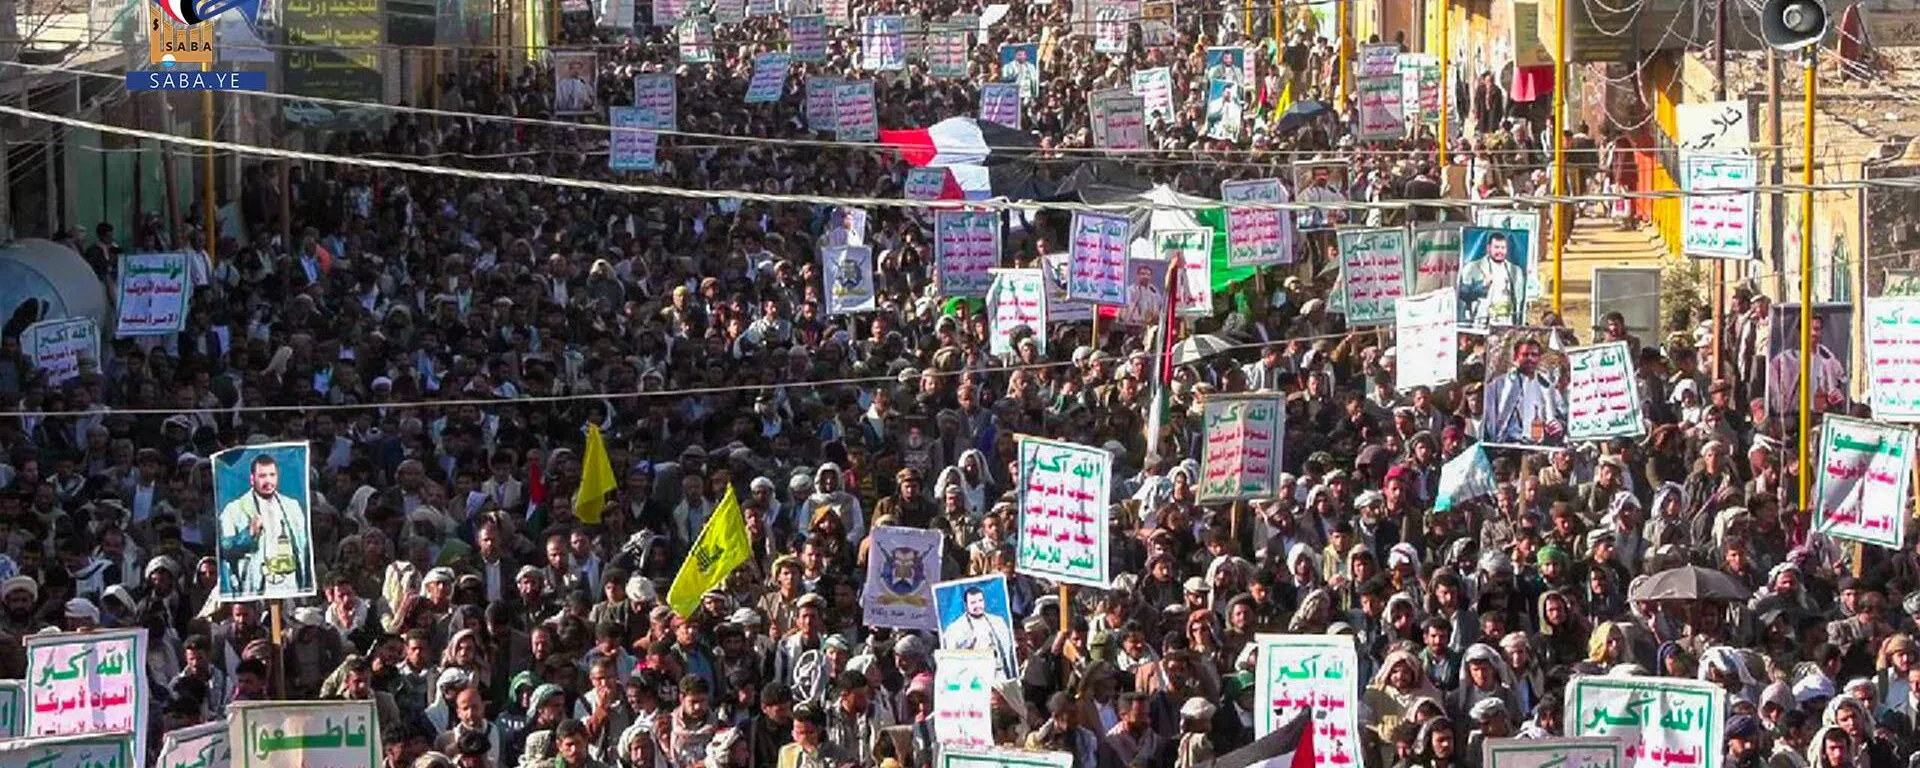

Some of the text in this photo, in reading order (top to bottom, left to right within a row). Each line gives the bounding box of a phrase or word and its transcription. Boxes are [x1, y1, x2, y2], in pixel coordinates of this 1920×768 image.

[1208, 403, 1246, 430] كبر
[1065, 547, 1095, 571] لنصر
[34, 645, 131, 690] الله أكبر
[90, 685, 132, 710] الموت
[1585, 691, 1703, 734] الله أكبر
[251, 715, 367, 760] قاطعوا
